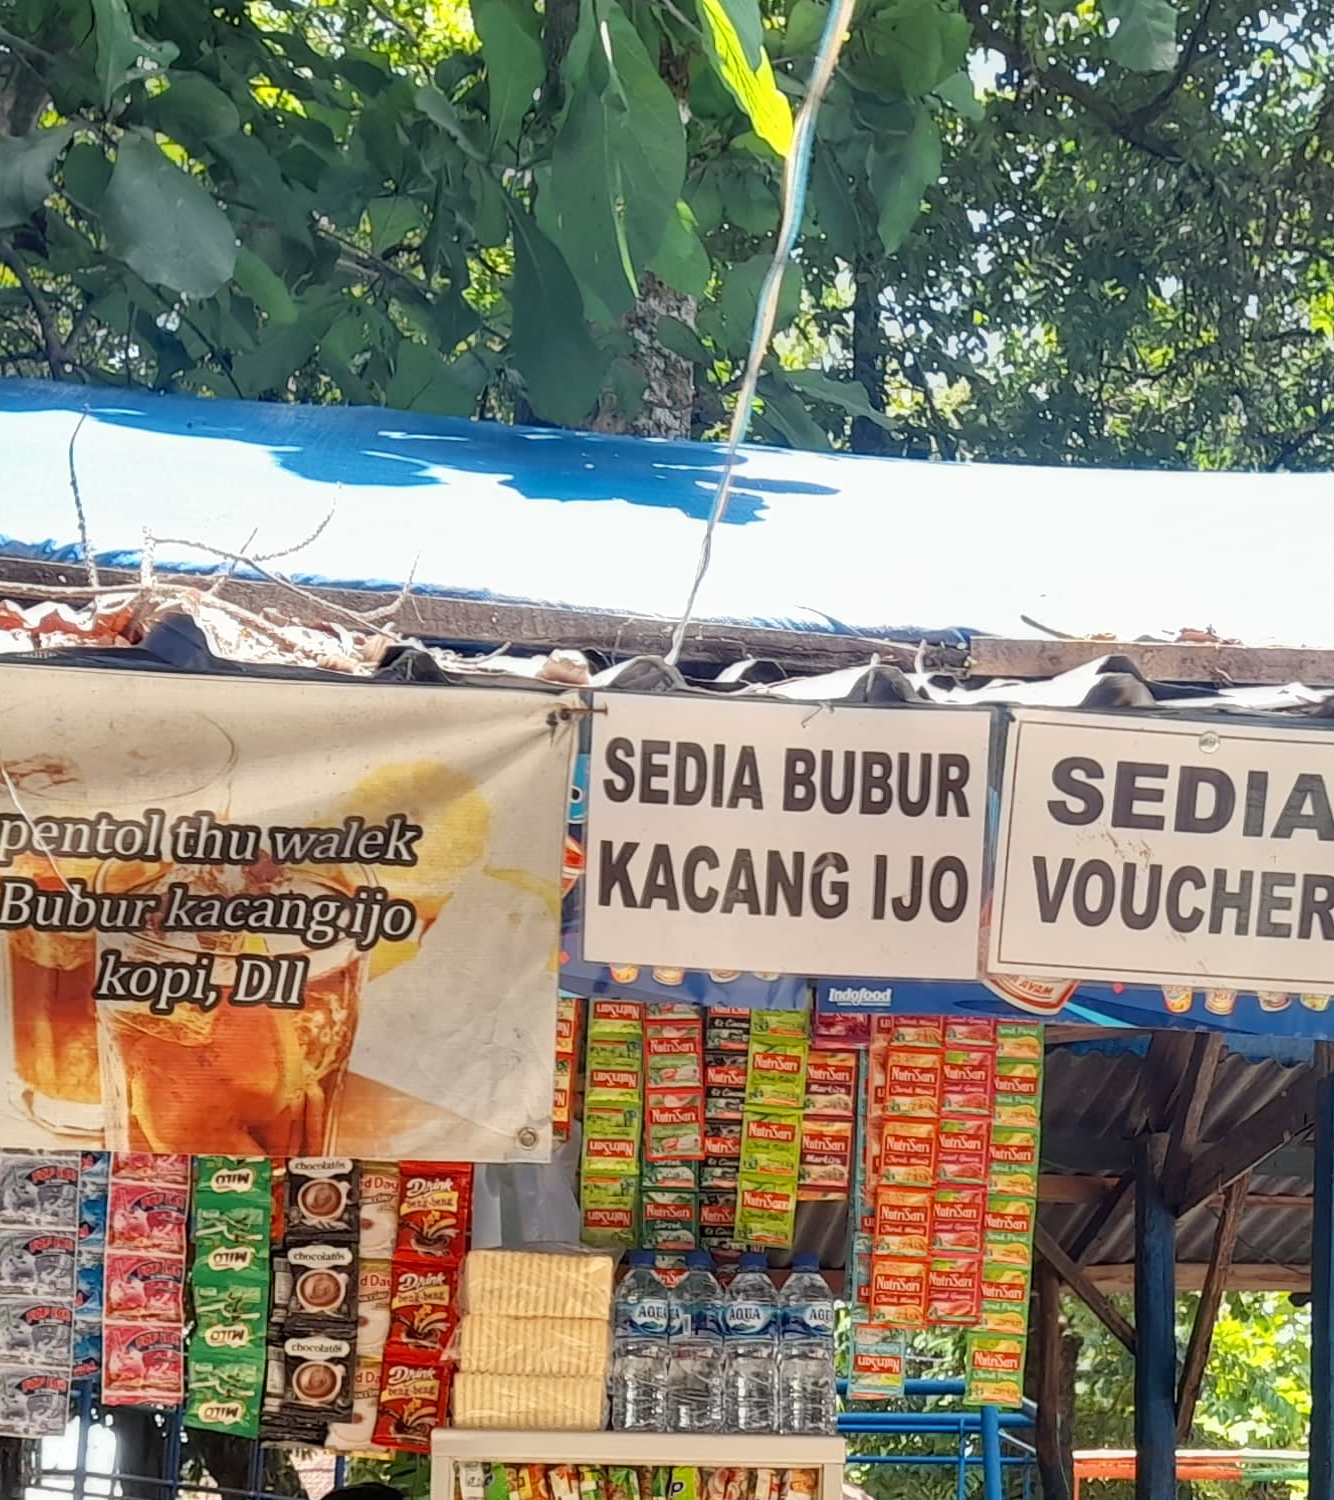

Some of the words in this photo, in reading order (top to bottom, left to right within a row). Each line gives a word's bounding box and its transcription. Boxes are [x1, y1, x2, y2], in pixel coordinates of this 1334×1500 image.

[602, 736, 764, 810] SEDIA
[783, 747, 971, 818] BUBUR
[173, 815, 261, 861] thu
[268, 814, 423, 866] walek
[597, 840, 850, 921] KACANG
[872, 853, 969, 924] IJO
[165, 885, 341, 946] kacang
[347, 890, 415, 946] ijo
[97, 954, 218, 1010] kopi,
[232, 959, 307, 1006] Dll
[828, 987, 893, 1007] Indofood
[214, 1172, 251, 1187] MILO
[406, 1177, 455, 1197] Drink
[212, 1251, 248, 1265] MILO
[397, 1271, 446, 1291] Drink
[728, 1306, 762, 1322] AQUA
[209, 1328, 245, 1343] MILO
[388, 1365, 438, 1385] Drink
[203, 1406, 240, 1421] MILO
